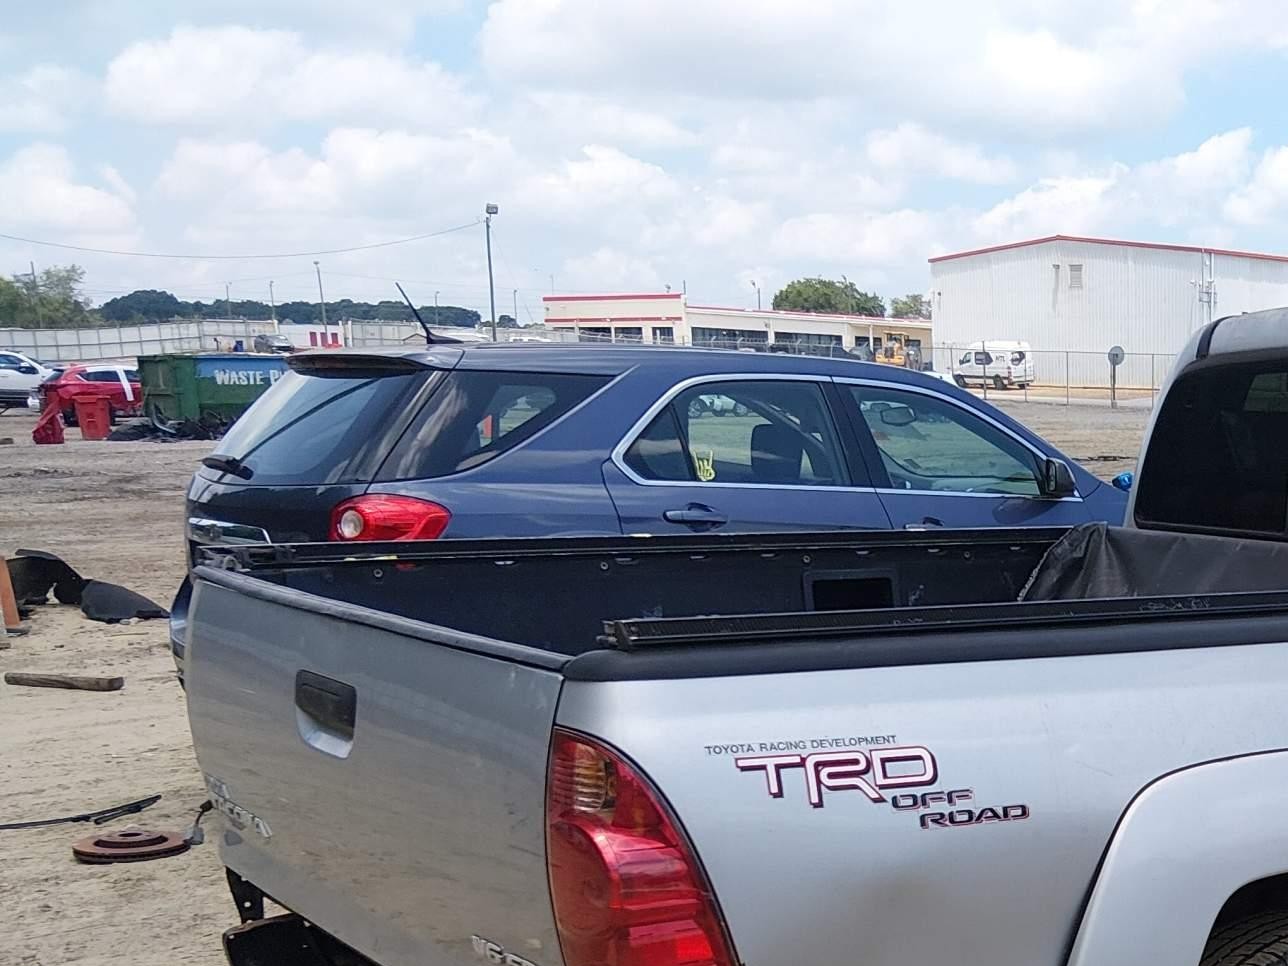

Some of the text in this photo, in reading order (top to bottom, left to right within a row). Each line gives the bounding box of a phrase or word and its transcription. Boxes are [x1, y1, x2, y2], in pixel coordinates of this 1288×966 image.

[214, 369, 264, 385] WASTE
[704, 735, 897, 755] TOYOTA RACING DEVELOPMENT
[735, 746, 938, 808] TRD
[892, 788, 974, 810] OFF
[919, 804, 1030, 829] ROAD
